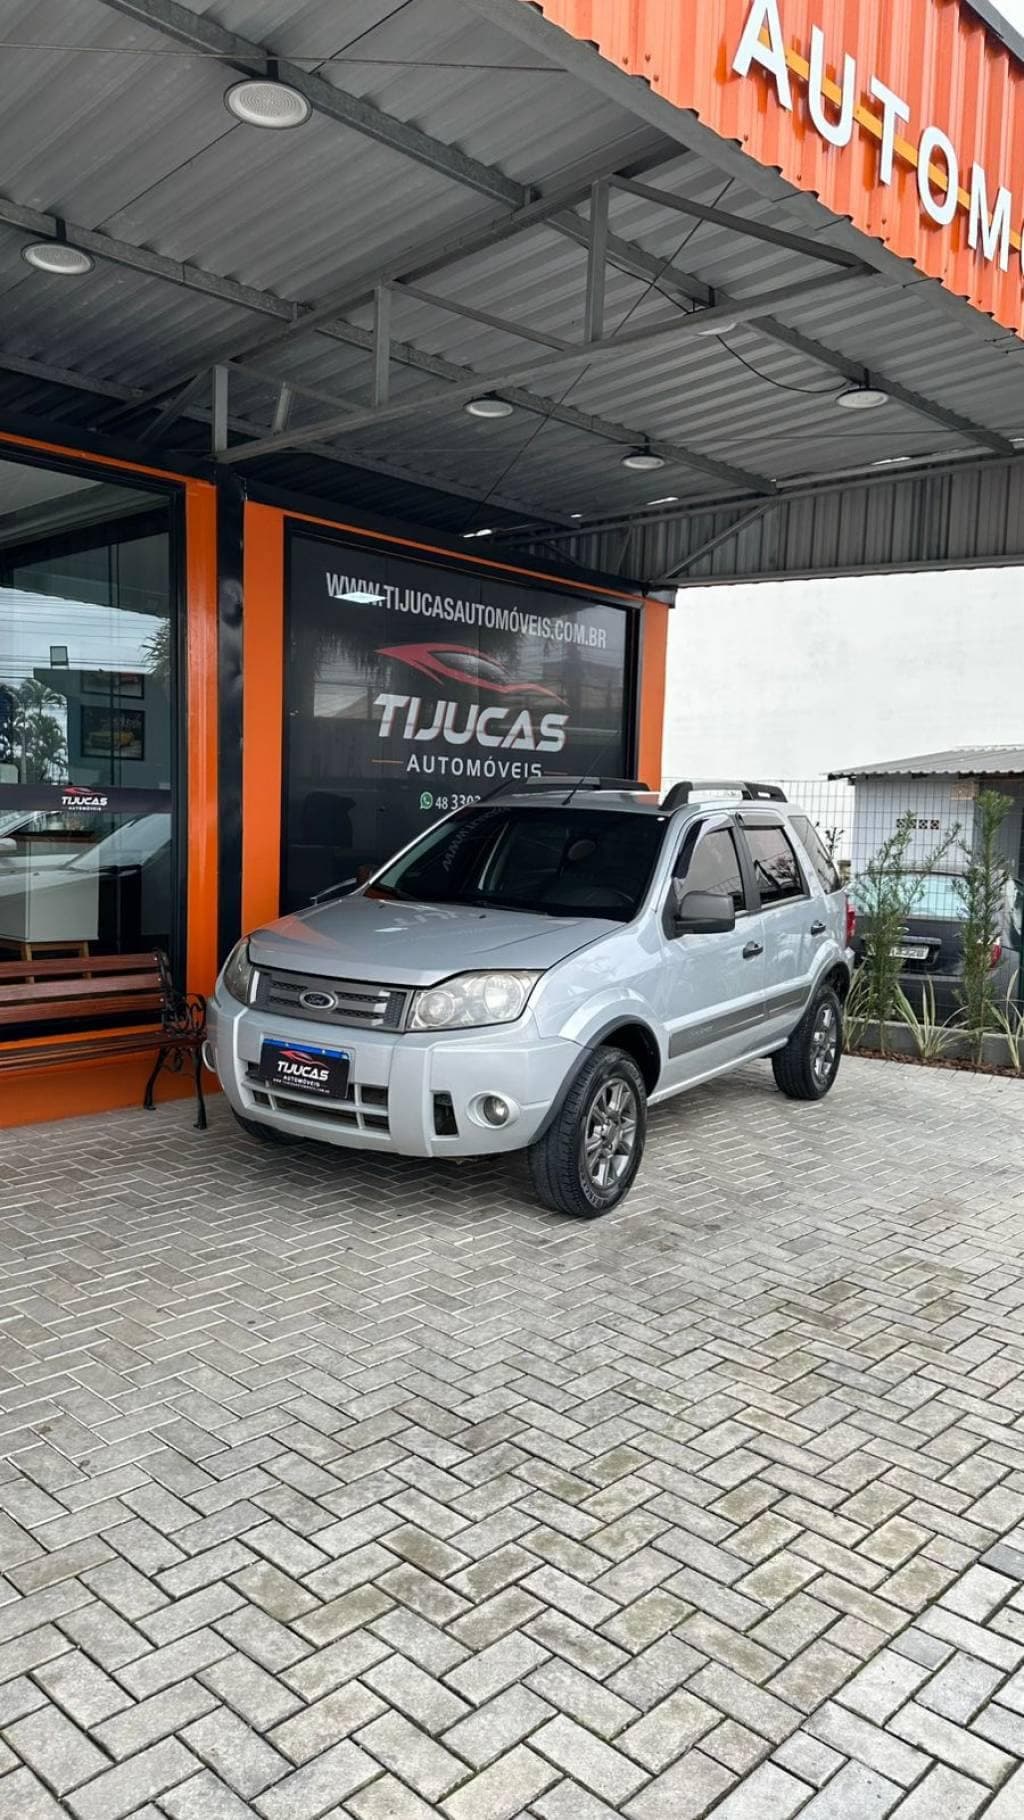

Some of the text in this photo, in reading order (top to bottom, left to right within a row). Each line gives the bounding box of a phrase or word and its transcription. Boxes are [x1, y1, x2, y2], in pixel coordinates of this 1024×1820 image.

[731, 0, 1024, 273] AUTOM
[374, 693, 569, 752] TIJUCAS
[406, 754, 542, 778] AUTOMÓVEIS
[62, 796, 108, 806] TIJUCAS
[435, 796, 448, 810] 48
[277, 1061, 330, 1082] TIJUCAS
